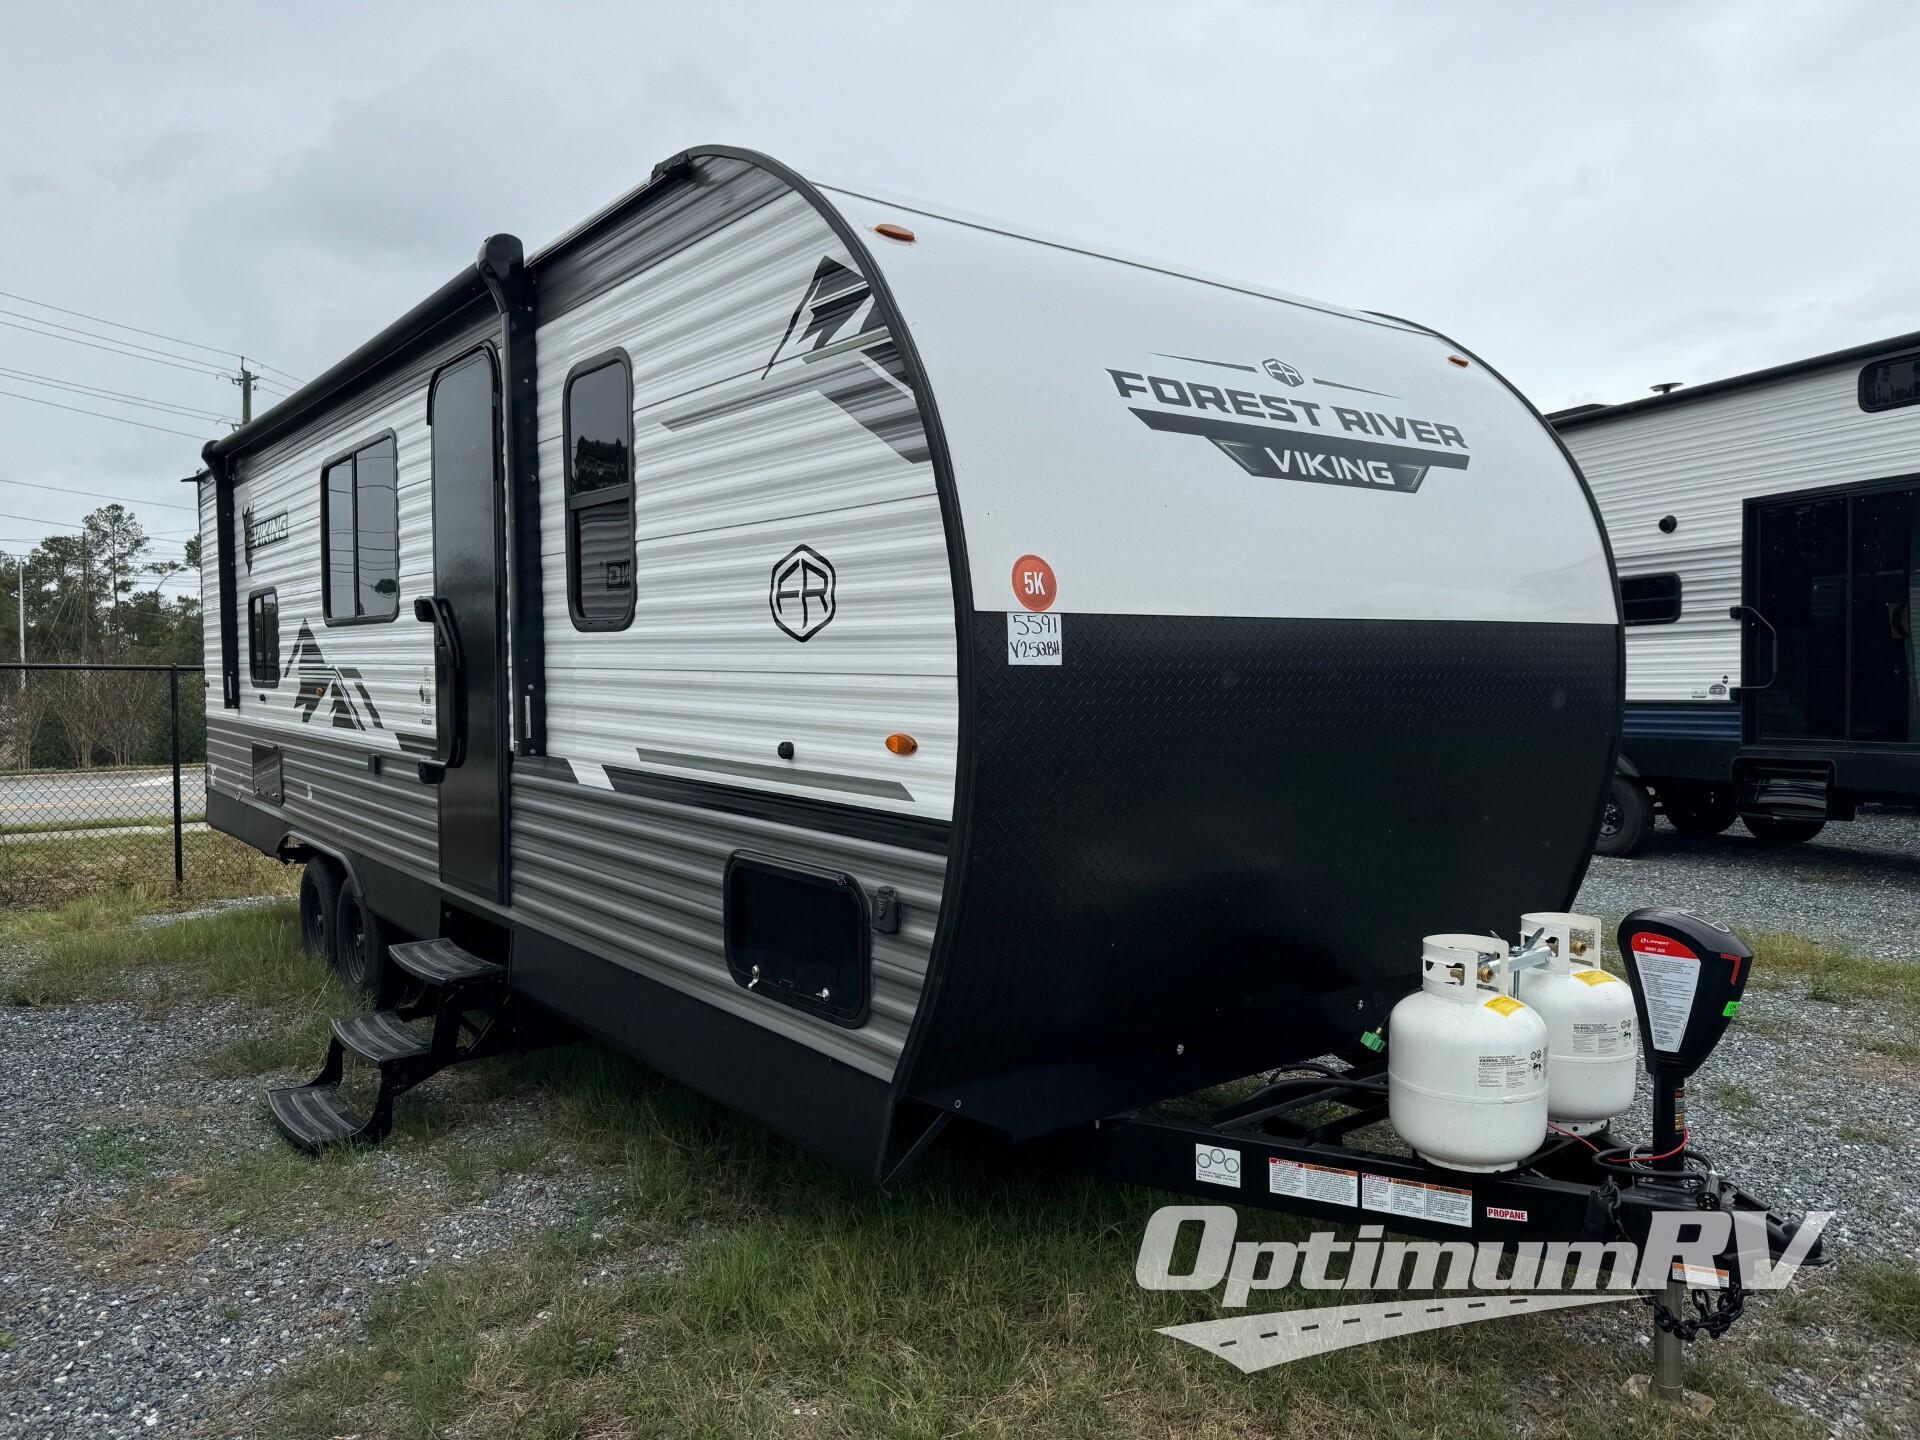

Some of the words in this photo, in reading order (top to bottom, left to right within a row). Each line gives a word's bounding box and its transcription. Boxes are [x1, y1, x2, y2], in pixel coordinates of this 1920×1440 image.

[1105, 368, 1321, 427] FOREST
[1330, 405, 1470, 449] RIVER
[1264, 446, 1395, 485] VIKING
[1023, 571, 1046, 596] 5K
[1012, 614, 1057, 636] 5591
[1488, 1208, 1526, 1220] PROPANE
